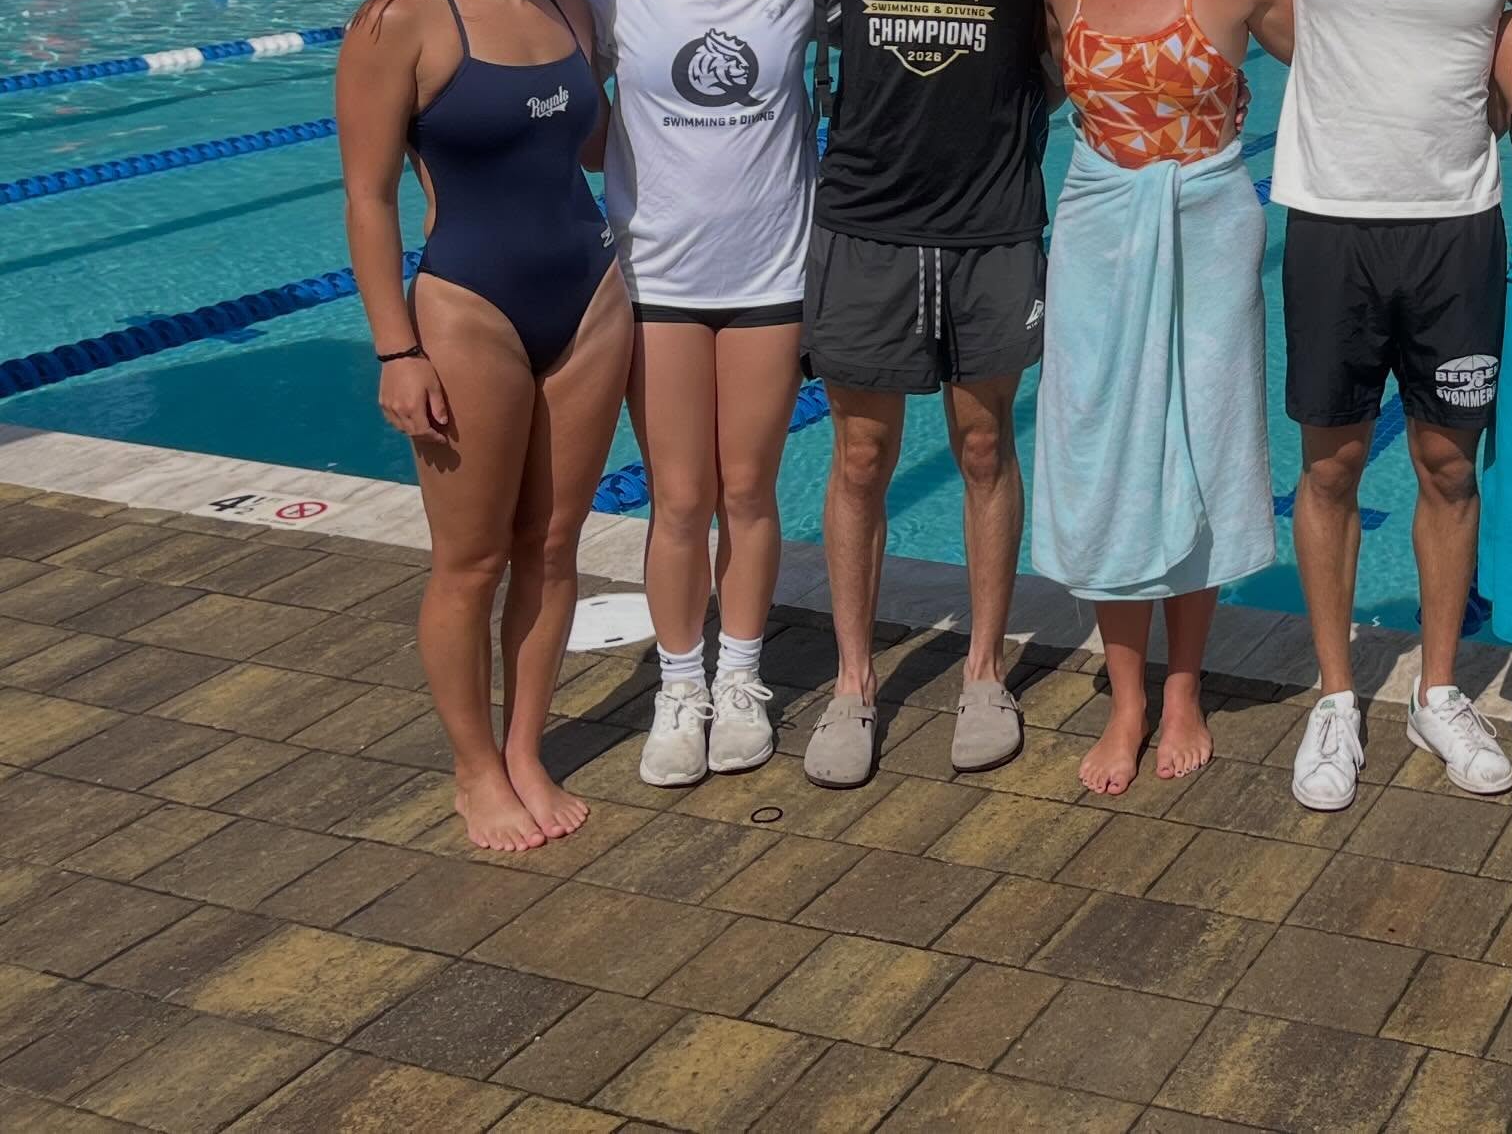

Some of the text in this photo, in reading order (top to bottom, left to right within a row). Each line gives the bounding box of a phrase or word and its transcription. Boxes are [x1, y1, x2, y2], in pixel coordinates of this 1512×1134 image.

[871, 2, 985, 17] SWIMMING & DIVING
[868, 17, 987, 52] CHAMPIONS
[907, 51, 942, 62] 2026
[526, 85, 569, 119] Royals
[663, 111, 775, 127] SWIMMING & DIVING
